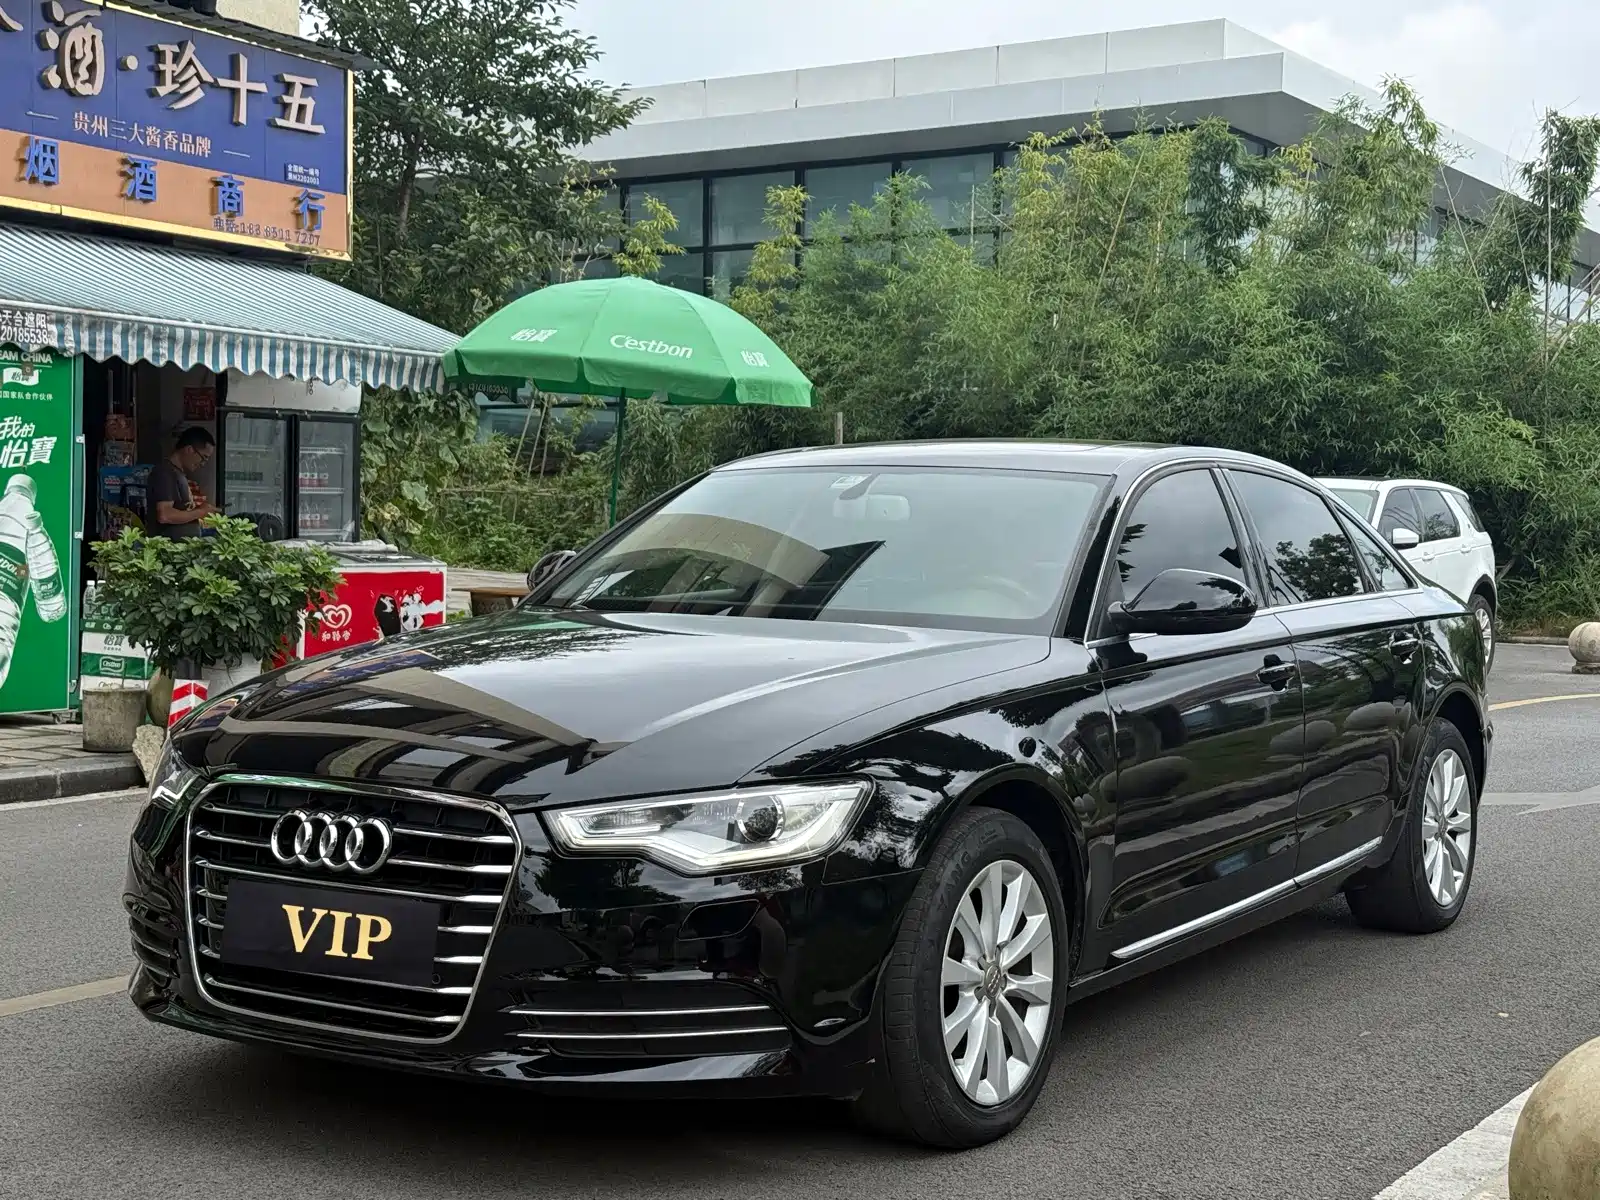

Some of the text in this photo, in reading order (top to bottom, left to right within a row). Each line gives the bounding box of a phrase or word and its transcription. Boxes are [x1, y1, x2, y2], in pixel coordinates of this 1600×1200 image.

[73, 112, 212, 158] 贵州三大酱香品牌
[24, 137, 326, 231] 烟酒商行
[0, 309, 47, 329] 天合遮阳
[0, 415, 36, 440] 我的
[282, 904, 392, 961] VIP
